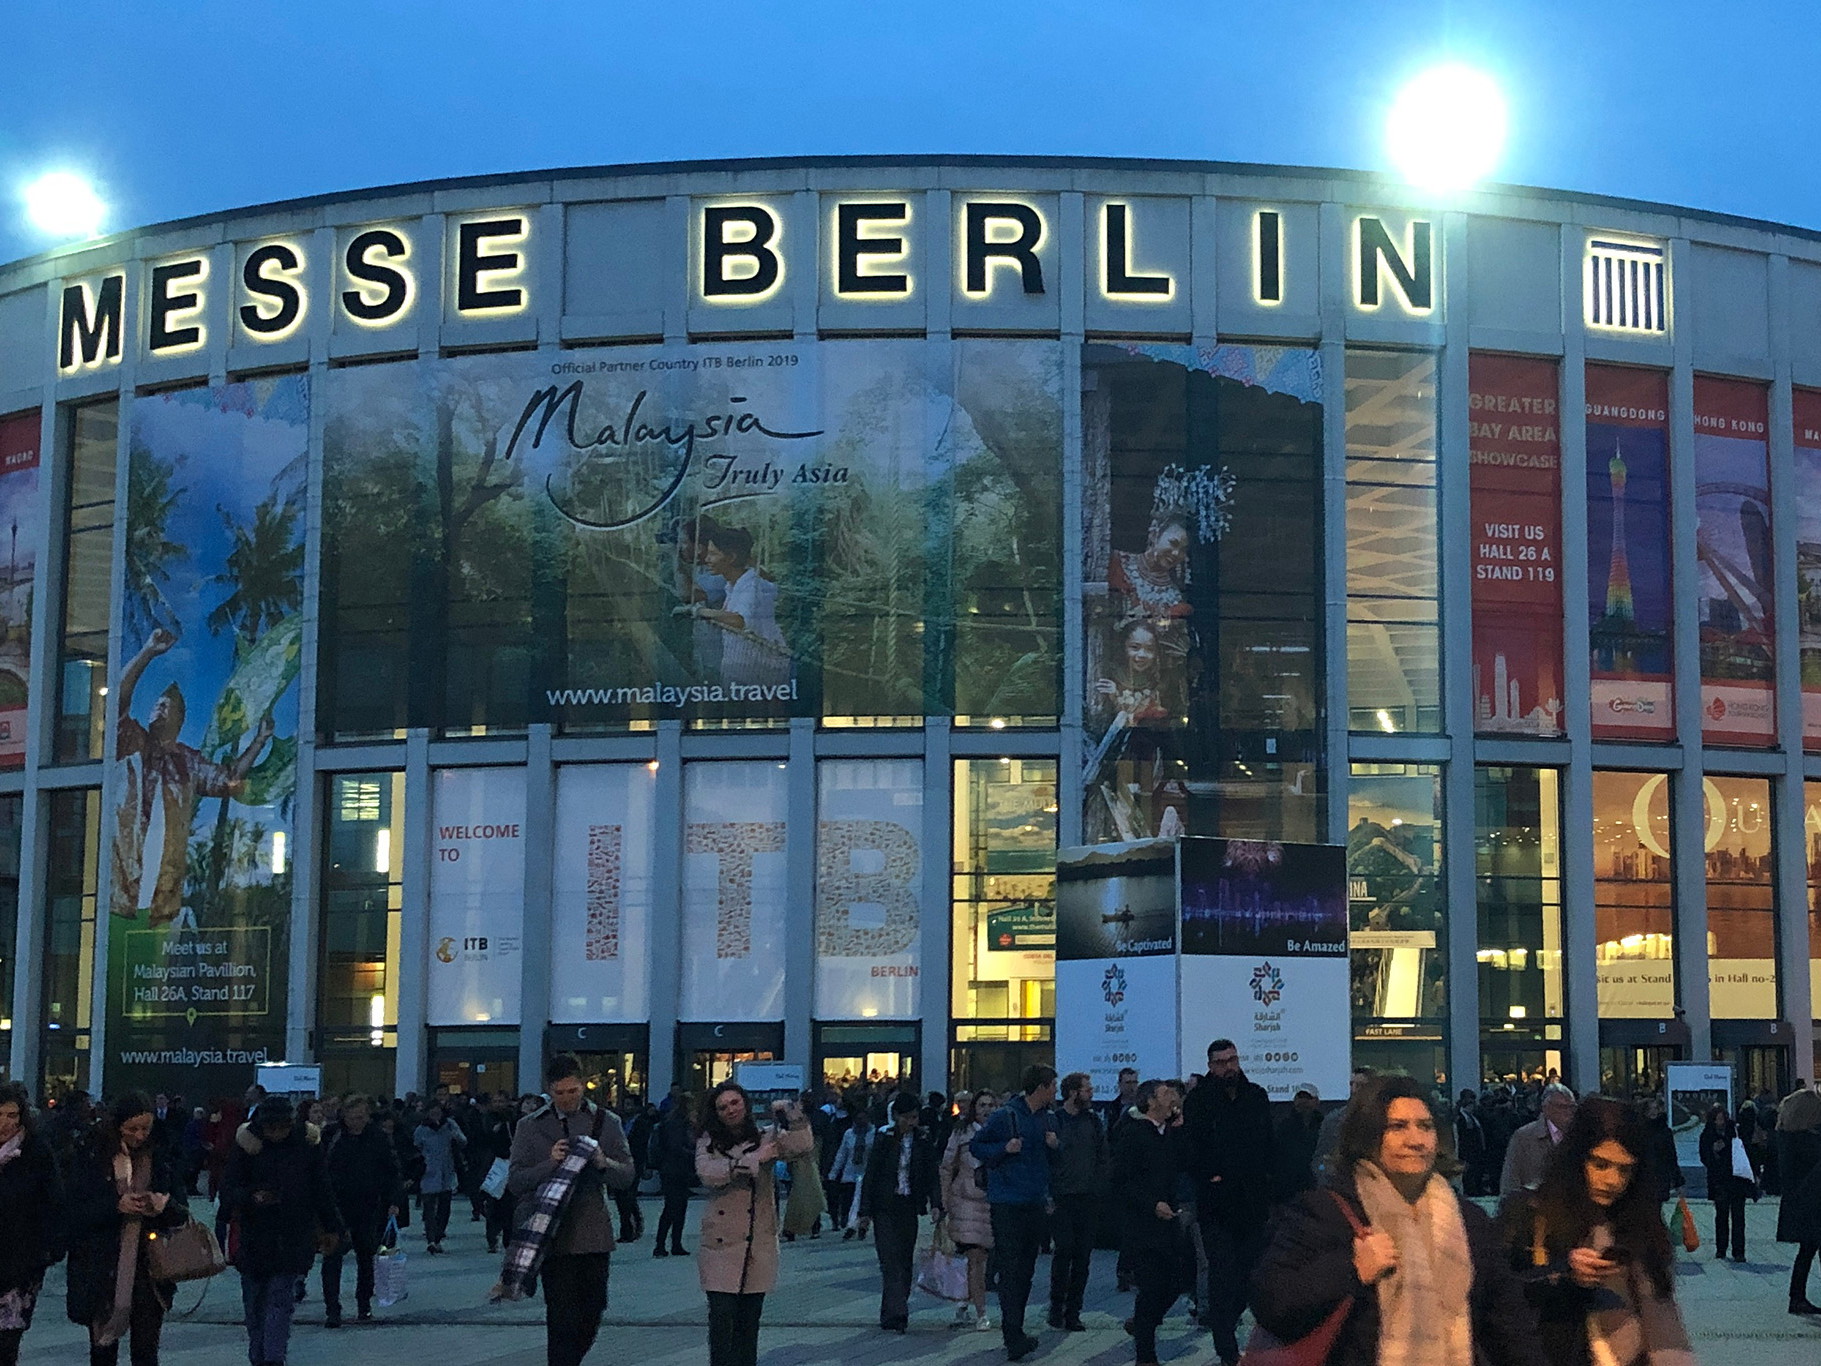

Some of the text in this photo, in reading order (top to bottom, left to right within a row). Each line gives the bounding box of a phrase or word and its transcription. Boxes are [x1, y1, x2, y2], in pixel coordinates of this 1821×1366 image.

[59, 201, 1432, 371] MESSE BERLIN
[551, 355, 799, 375] Official Partner Country ITB Berlin 2019
[1469, 394, 1556, 415] GREATER
[1585, 403, 1666, 422] GUANGDONG
[1694, 414, 1765, 434] HONG KONG
[1508, 424, 1557, 442] AREA
[1804, 429, 1821, 441] MA
[505, 380, 825, 528] Malaysia
[1469, 451, 1558, 469] SHOWCASE
[704, 454, 849, 490] Truly Asia
[1485, 523, 1545, 540] VISIT US
[1479, 544, 1551, 562] HALL 26 A
[1476, 565, 1555, 582] STAND 119
[546, 679, 799, 708] www.malaysia.travel
[439, 824, 520, 840] WELCOME
[439, 848, 460, 862] TO
[162, 941, 228, 956] Meet us at
[463, 937, 489, 951] ITB
[1128, 936, 1173, 954] Captivated
[1287, 940, 1346, 953] Be Amazed
[133, 964, 195, 982] Malaysian
[870, 966, 919, 978] BERLIN
[1612, 976, 1624, 984] us
[1627, 976, 1638, 984] at
[1641, 973, 1672, 984] Stand
[1715, 974, 1725, 983] in
[1728, 973, 1748, 983] Hall
[134, 985, 256, 1003] Hall 26A, Stand 117
[577, 1027, 587, 1039] C
[713, 1025, 724, 1037] C
[1254, 1022, 1281, 1033] Sharjah
[1658, 1022, 1667, 1034] B
[1770, 1023, 1778, 1034] B
[120, 1047, 268, 1068] www.malaysia.travel
[1266, 1084, 1290, 1094] Stand
